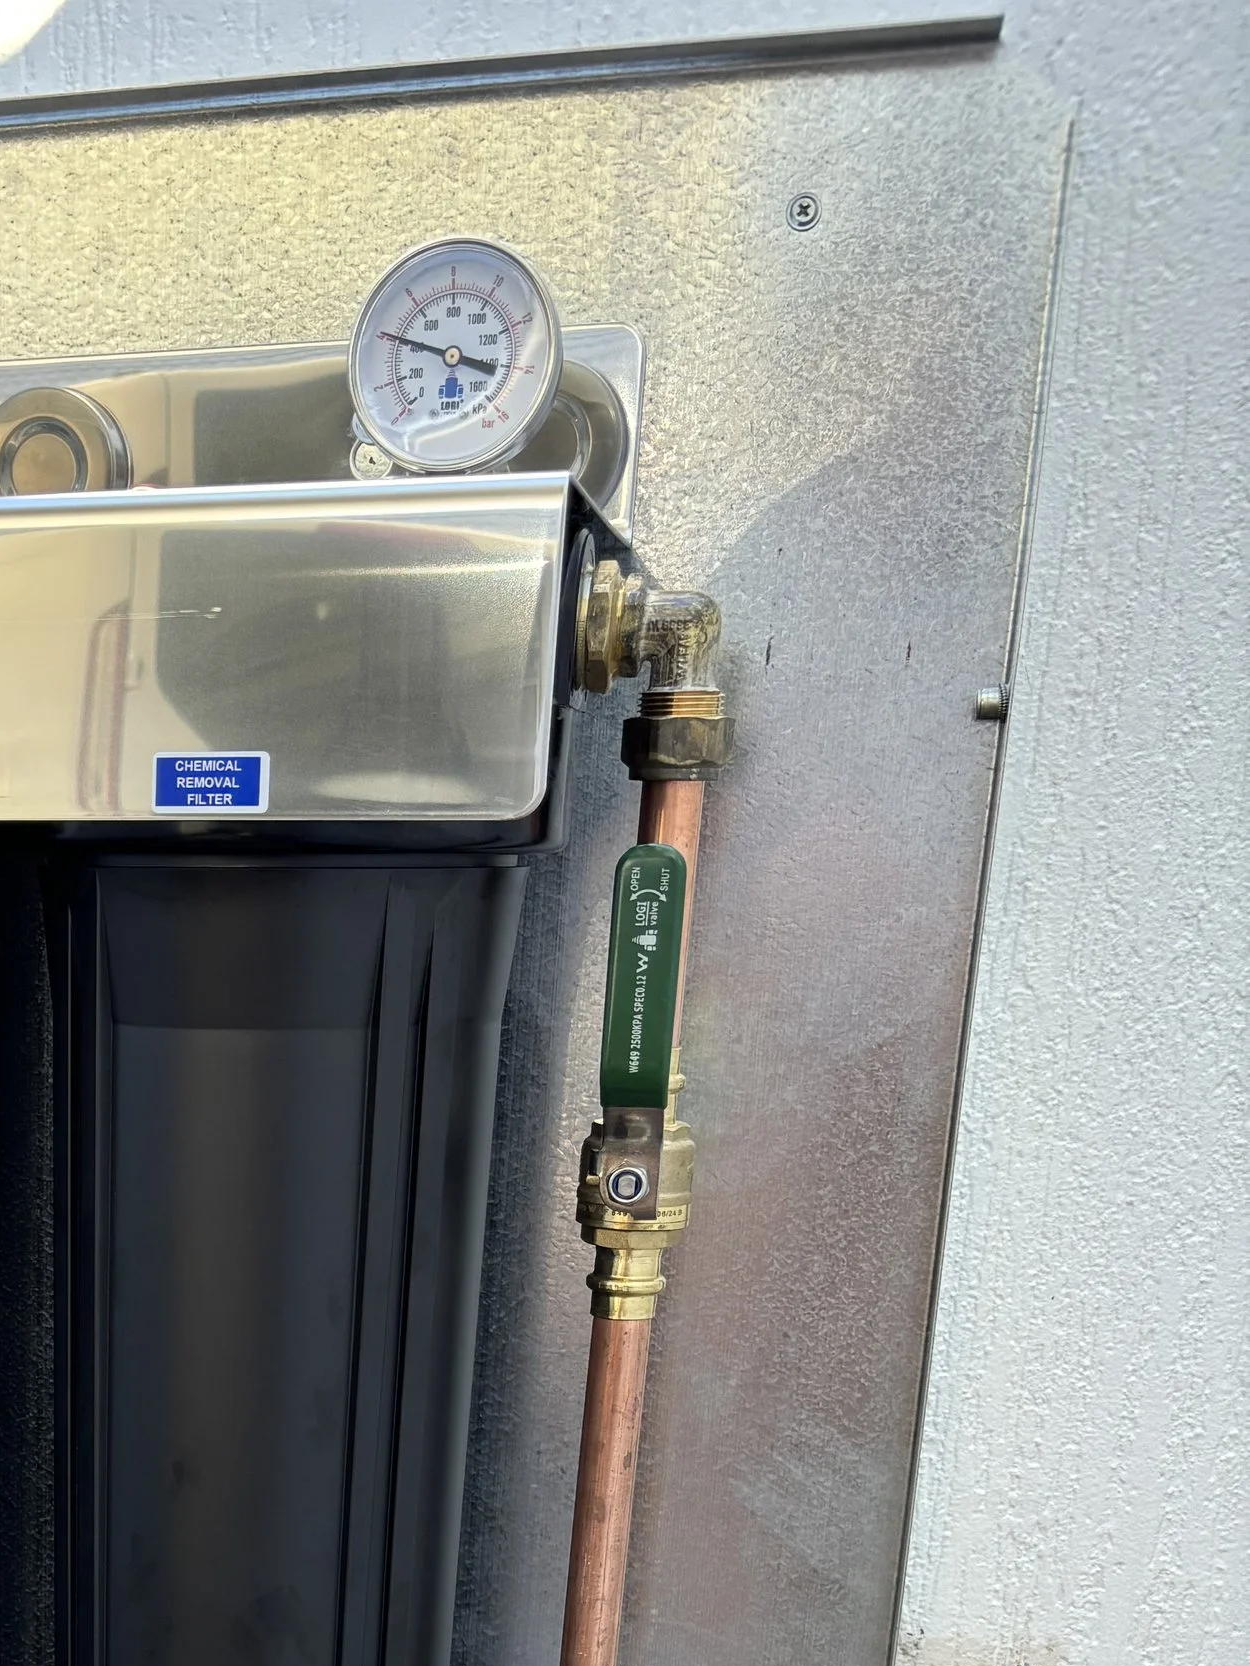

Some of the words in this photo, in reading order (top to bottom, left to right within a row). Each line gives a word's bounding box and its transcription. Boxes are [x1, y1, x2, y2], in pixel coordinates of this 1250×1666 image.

[493, 274, 503, 287] 10
[446, 306, 461, 318] 800
[467, 313, 486, 325] 1000
[424, 320, 439, 332] 600
[478, 334, 498, 346] 1200
[409, 368, 423, 379] 200
[418, 387, 425, 397] 0
[469, 380, 488, 392] 1600
[481, 418, 494, 429] bar
[175, 760, 242, 772] CHEMICAL
[176, 777, 240, 789] REMOVAL
[187, 794, 232, 805] FILTER
[630, 867, 641, 891] OPEN
[660, 868, 670, 892] SHUT
[635, 901, 647, 926] LOGI
[650, 901, 659, 926] valve
[630, 1014, 643, 1049] 2500KPA
[628, 1050, 641, 1074] W649
